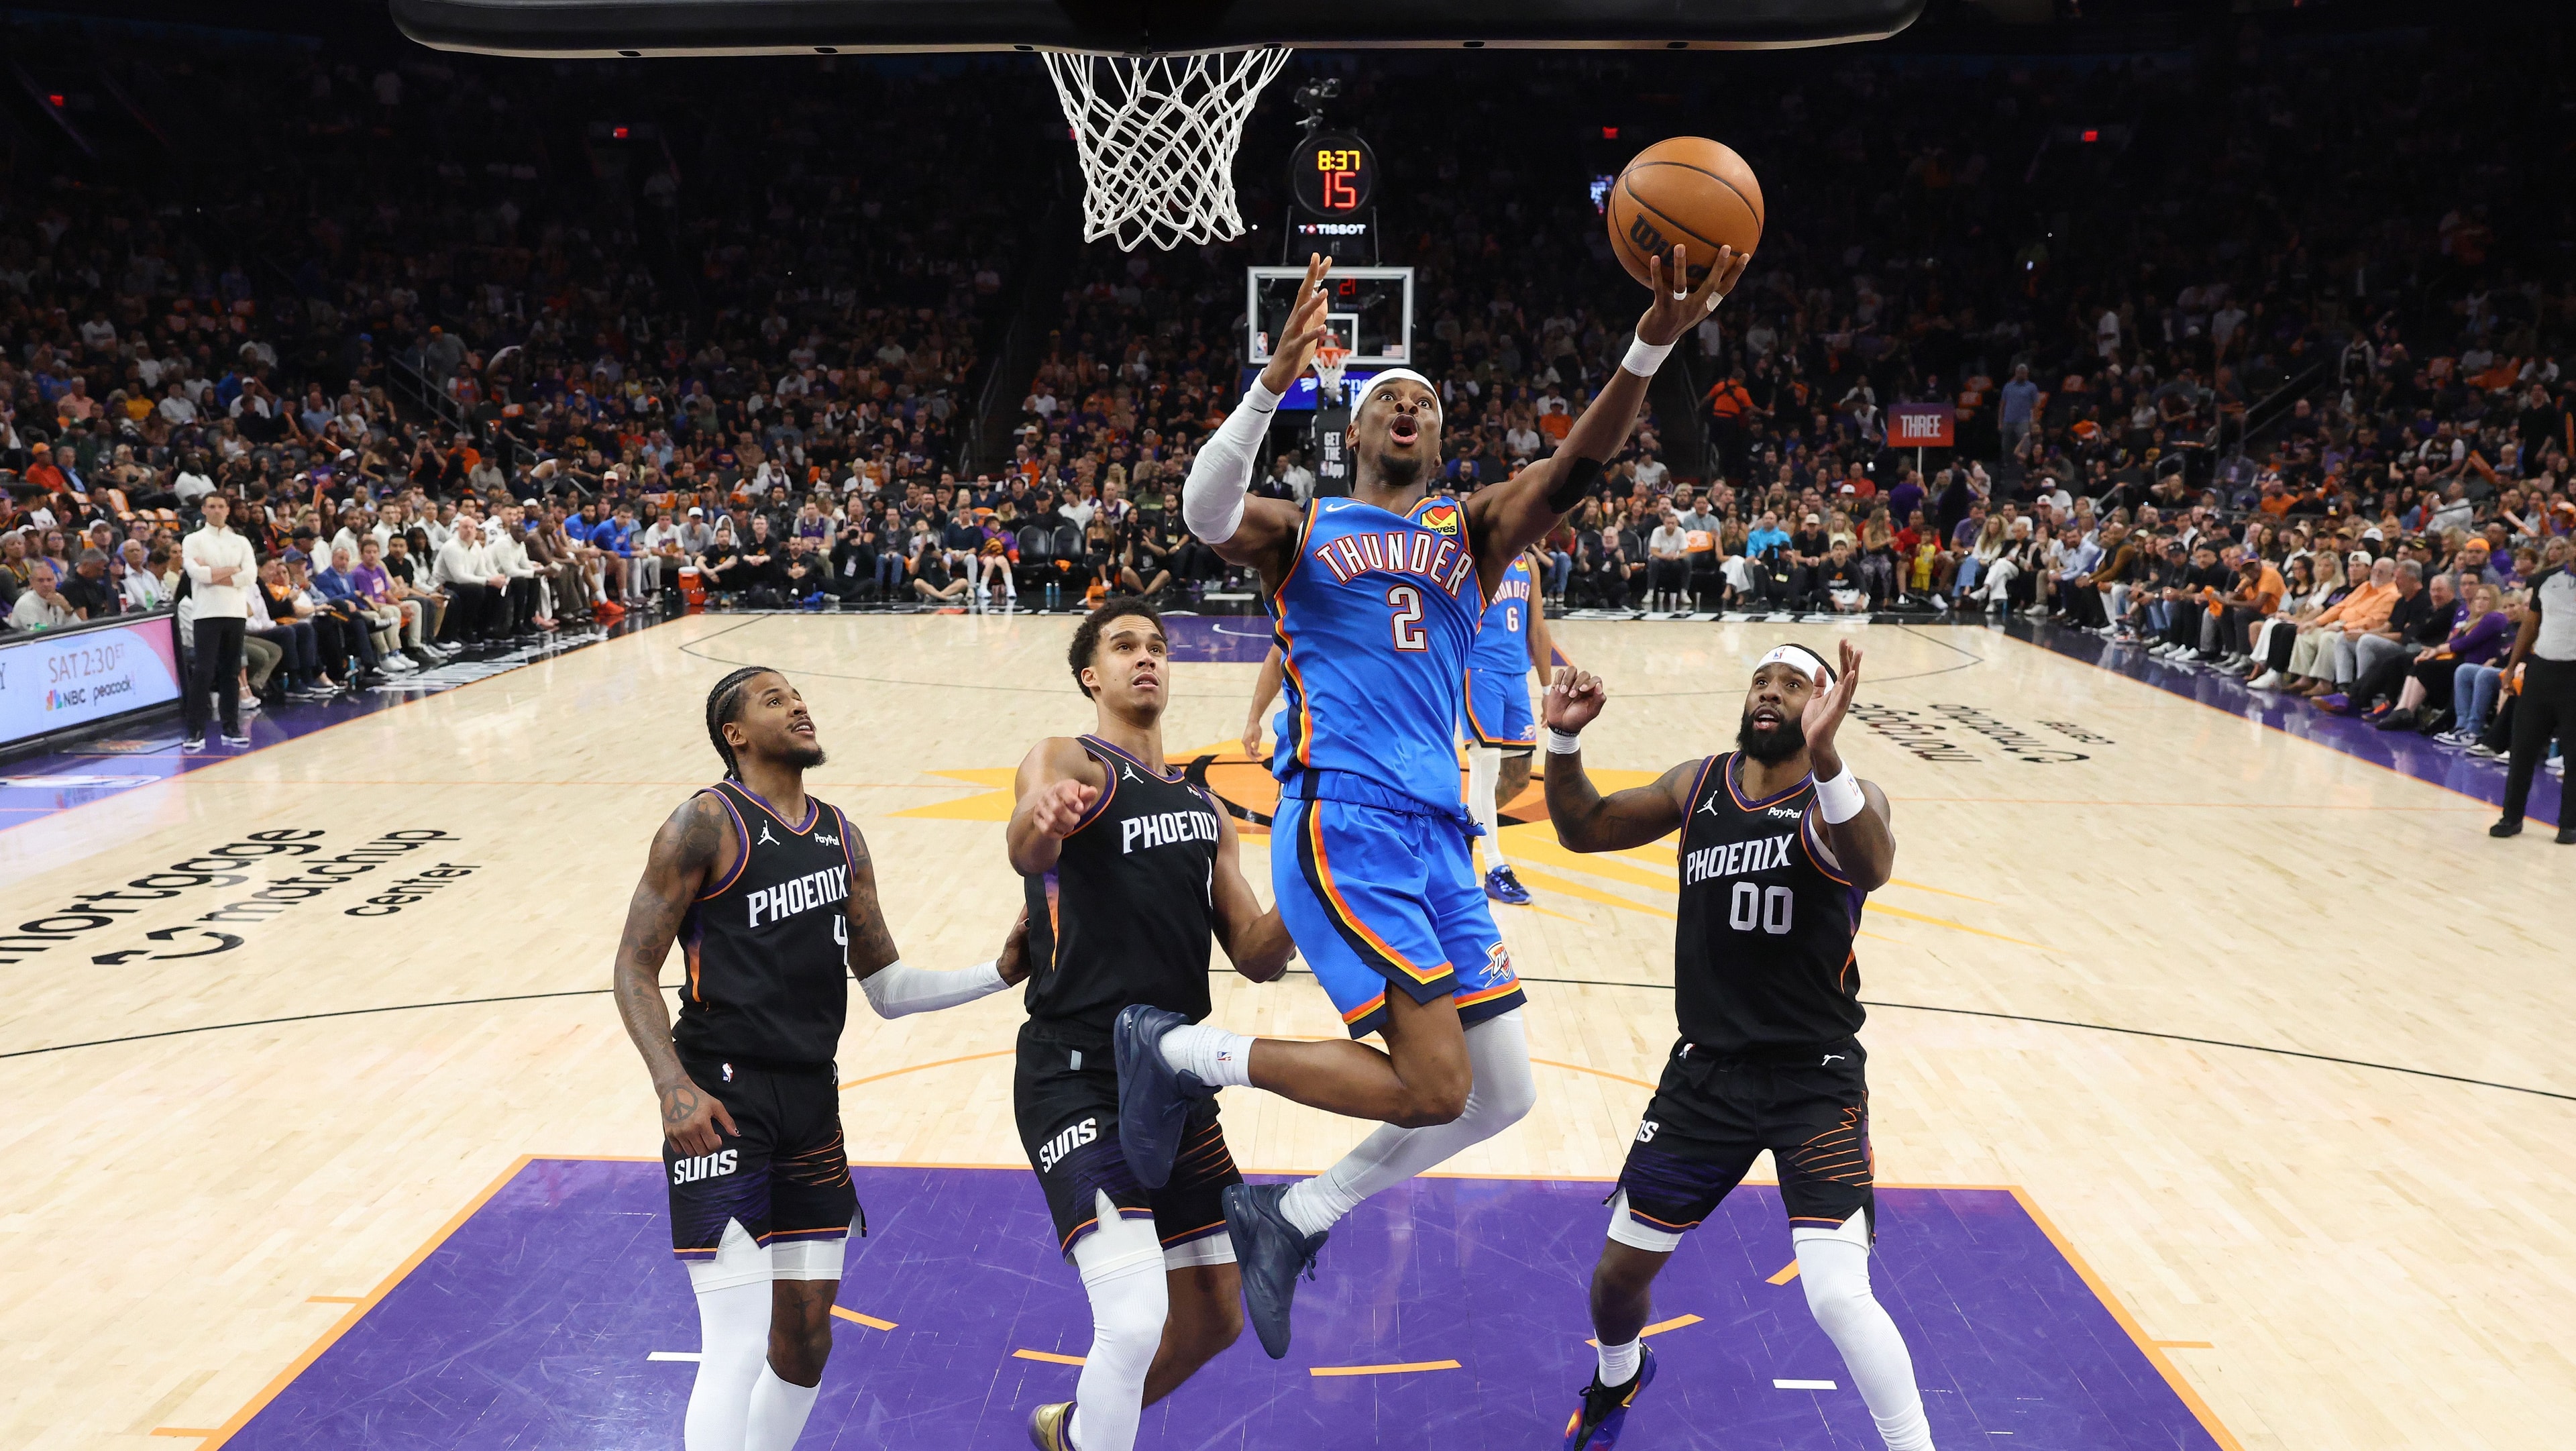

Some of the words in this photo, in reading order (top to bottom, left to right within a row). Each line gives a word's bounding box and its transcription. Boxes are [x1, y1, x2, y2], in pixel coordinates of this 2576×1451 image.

[1318, 150, 1360, 170] 8:37
[1324, 171, 1356, 208] 15
[1316, 223, 1366, 235] TISSOT
[1324, 431, 1341, 446] GET
[1900, 414, 1941, 439] THREE
[1324, 446, 1341, 461] THE
[1313, 531, 1475, 599] THUNDER
[1387, 584, 1428, 652] 2
[1506, 606, 1519, 633] 6
[48, 653, 77, 684] SAT
[81, 646, 115, 676] 2:30
[62, 688, 86, 707] NBC
[93, 675, 132, 706] peacock
[1767, 806, 1803, 820] PayPal
[814, 832, 841, 847] PayPal
[1120, 810, 1220, 854] PHOENIX
[197, 829, 462, 922] matchup
[1686, 833, 1794, 886] PHOENIX
[343, 862, 482, 916] center
[746, 864, 849, 928] PHOENIX
[1729, 881, 1794, 934] 00
[833, 914, 849, 967] 4
[1039, 1116, 1098, 1174] SUNS
[674, 1148, 738, 1185] SUNS
